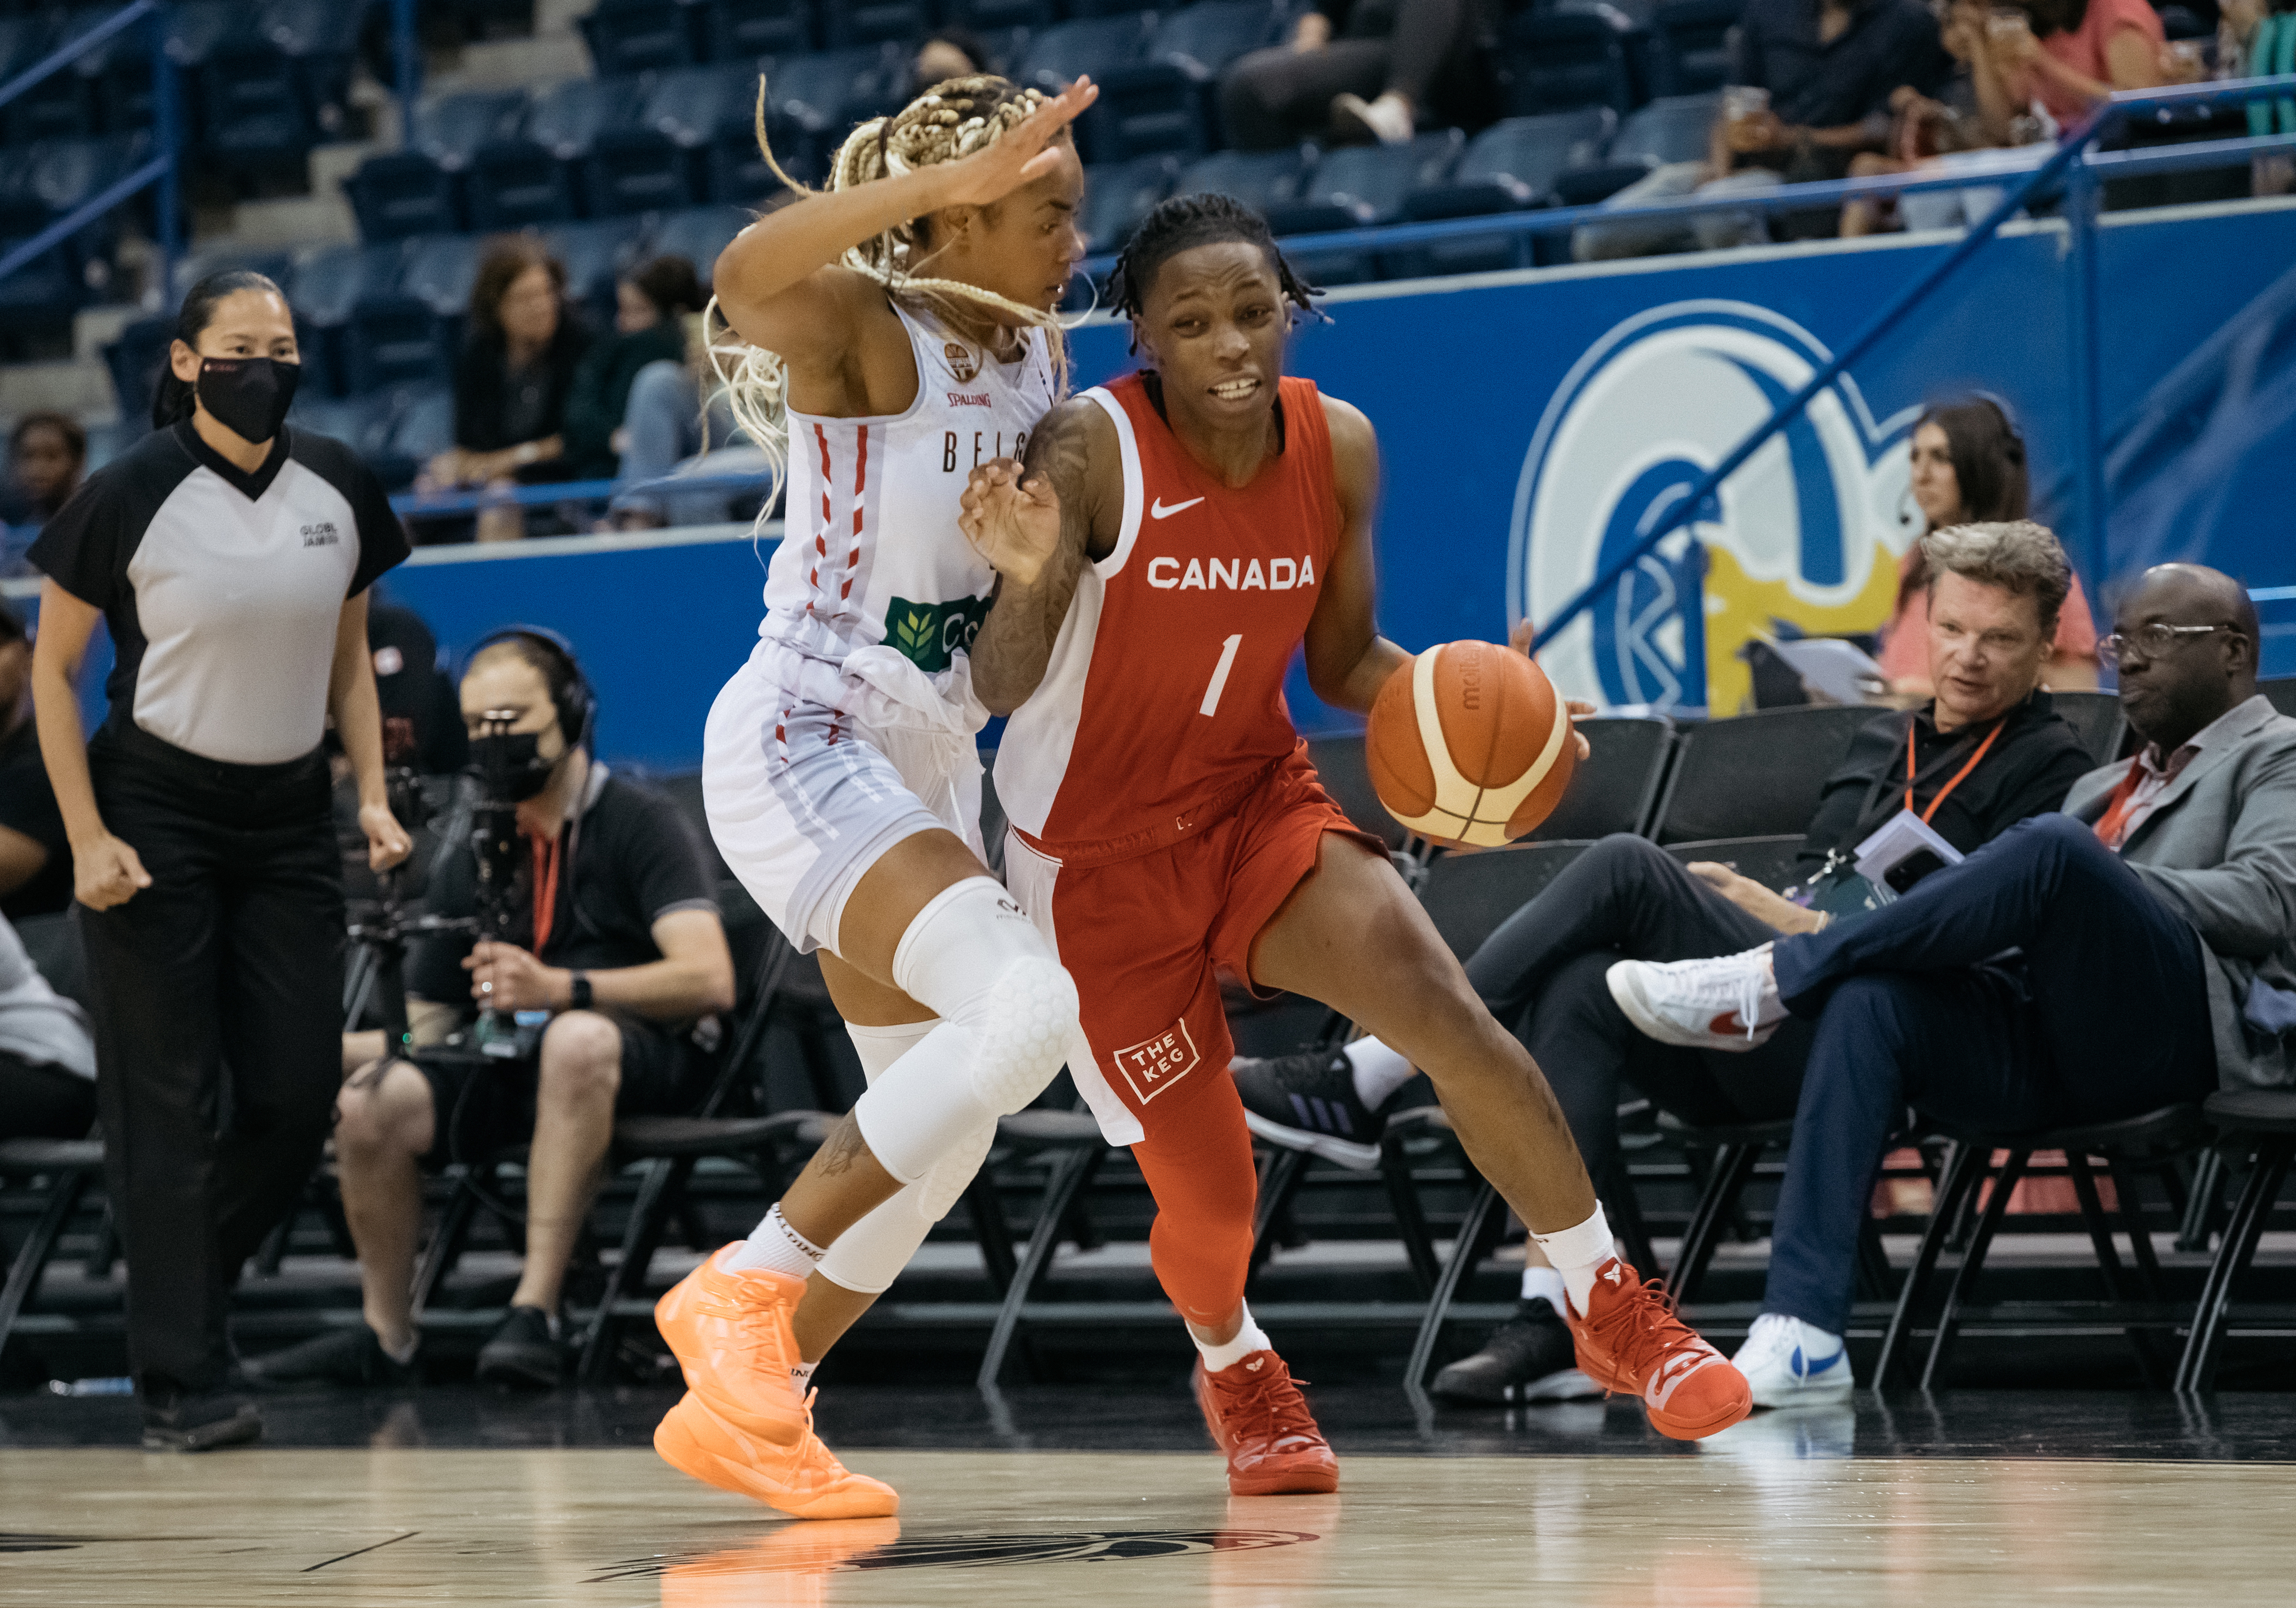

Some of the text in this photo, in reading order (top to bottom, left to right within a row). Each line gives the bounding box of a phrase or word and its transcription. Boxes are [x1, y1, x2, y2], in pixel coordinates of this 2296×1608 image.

[947, 392, 991, 408] SPALDING
[300, 522, 337, 536] GLOBL
[1146, 554, 1315, 591] CANADA
[1198, 634, 1243, 717] 1
[1131, 1032, 1175, 1066] THE
[1142, 1048, 1184, 1083] KEG
